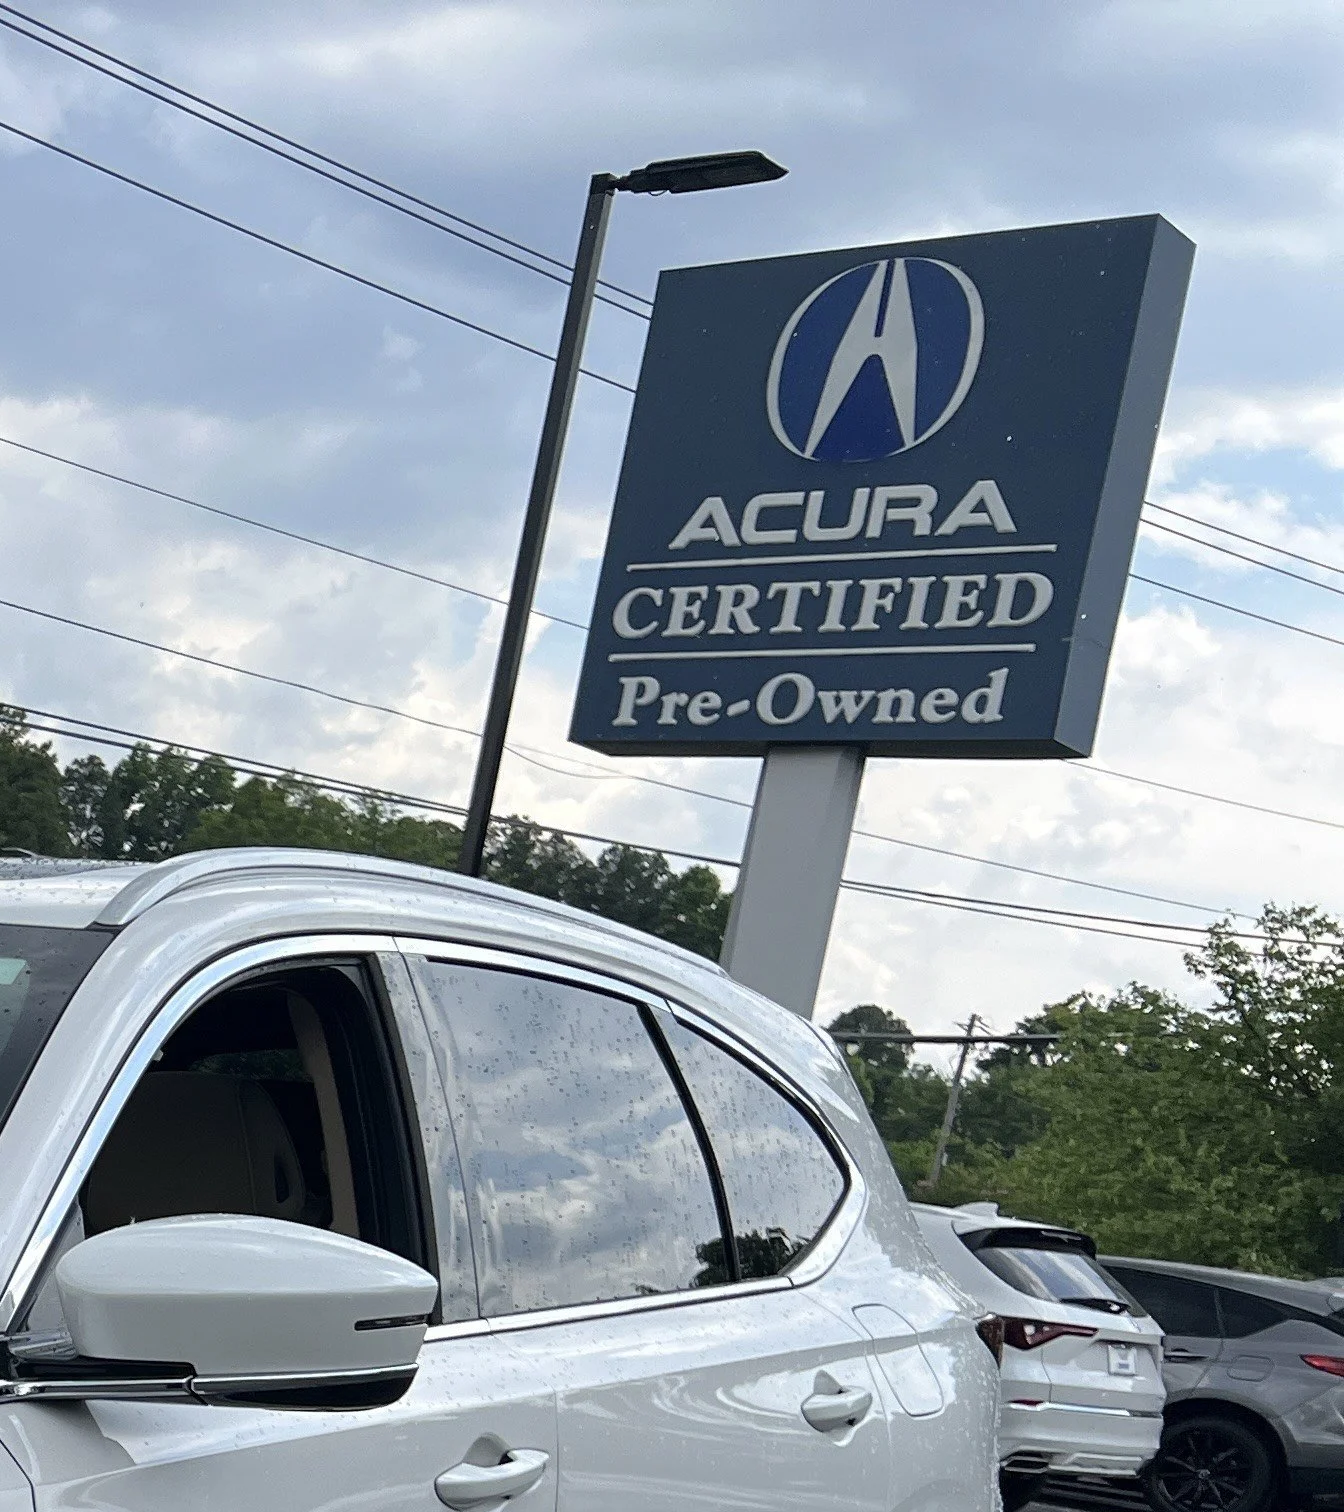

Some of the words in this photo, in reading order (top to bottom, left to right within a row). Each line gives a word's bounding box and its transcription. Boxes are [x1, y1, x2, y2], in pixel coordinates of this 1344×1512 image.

[667, 479, 1018, 550] ACURA
[611, 571, 1055, 641] CERTIFIED
[612, 667, 1010, 727] Pre-Owned
